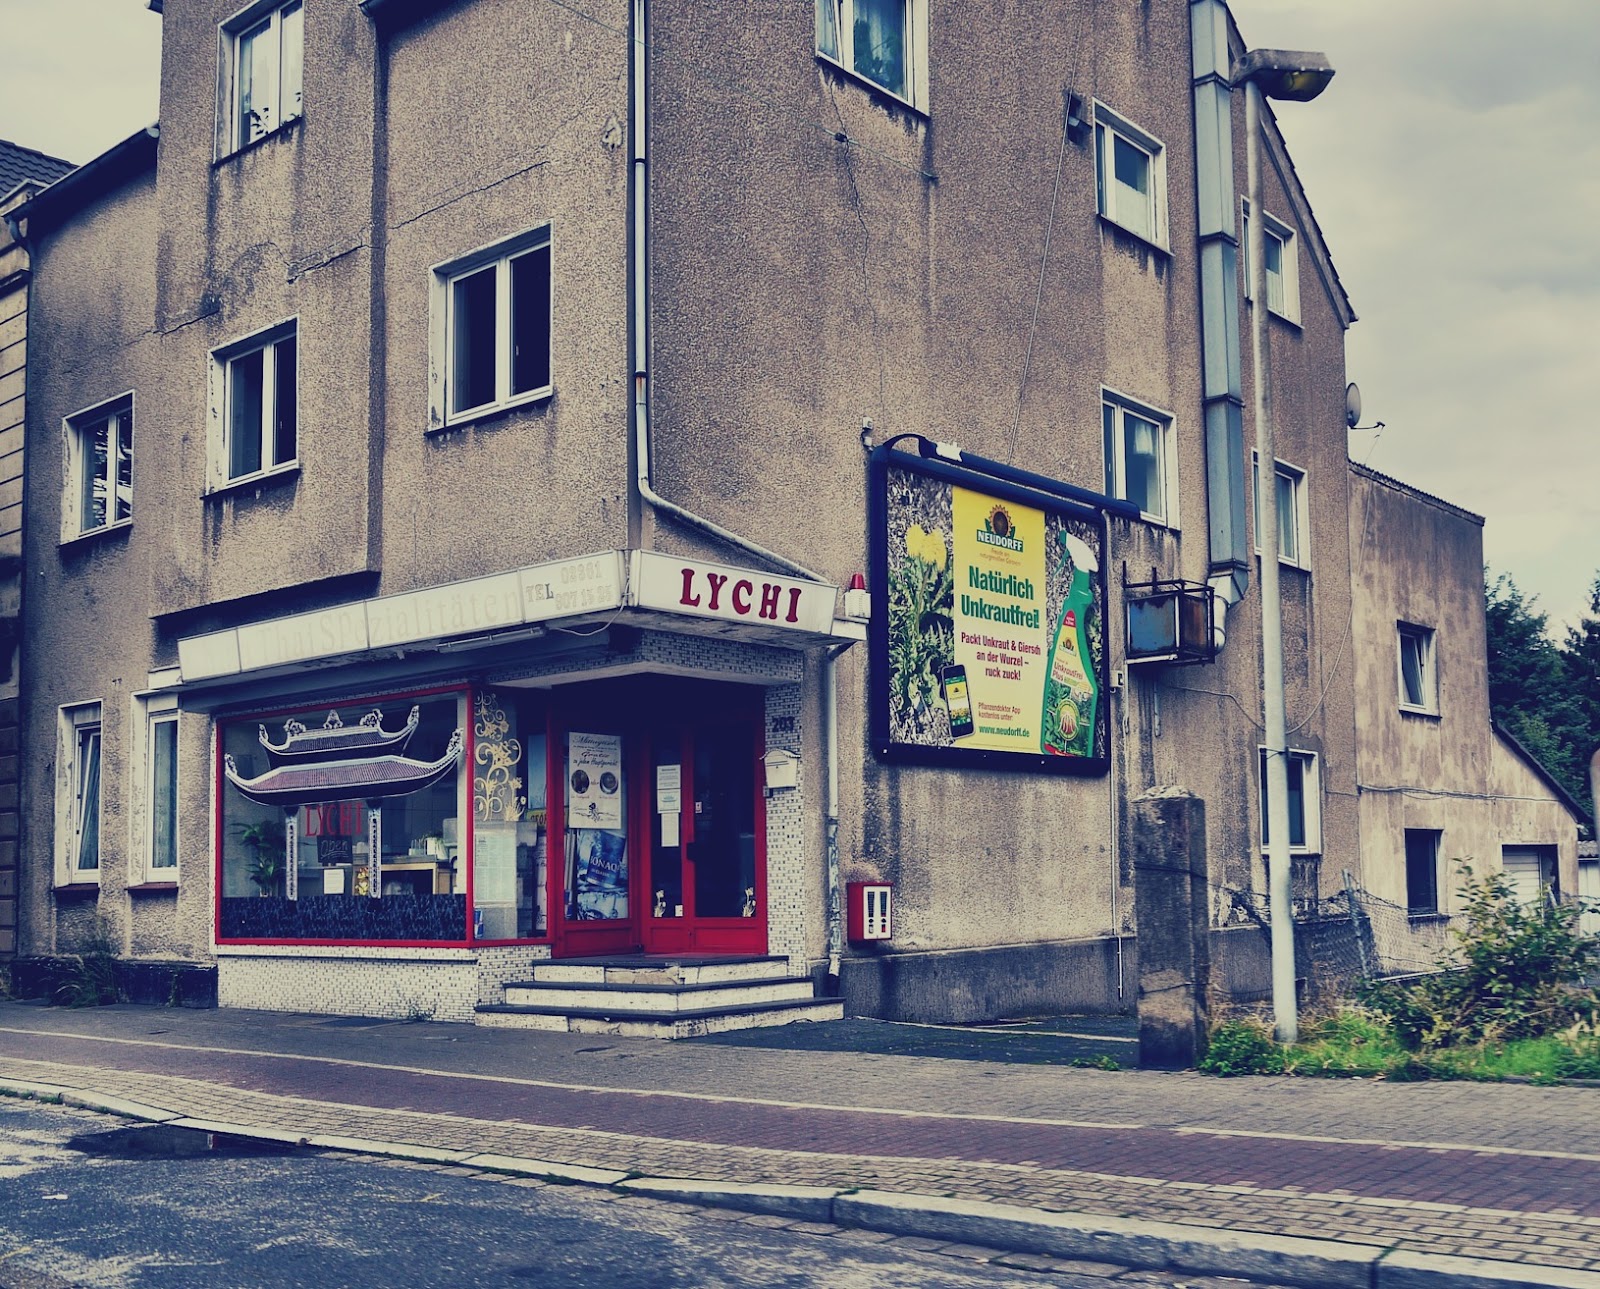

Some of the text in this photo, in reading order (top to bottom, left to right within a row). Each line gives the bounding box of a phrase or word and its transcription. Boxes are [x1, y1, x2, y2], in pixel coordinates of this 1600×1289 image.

[977, 530, 1022, 551] NEUDORFF
[969, 565, 1034, 600] Natürlich
[679, 568, 801, 623] LYCHI
[961, 632, 1041, 656] Packt Unkraut & Giersch
[977, 651, 985, 661] an
[987, 651, 999, 663] der
[1000, 653, 1023, 667] Wurzel
[986, 667, 1021, 681] ruck zuck!
[979, 725, 1030, 738] www.neudorff.de
[305, 802, 364, 837] LYCHI
